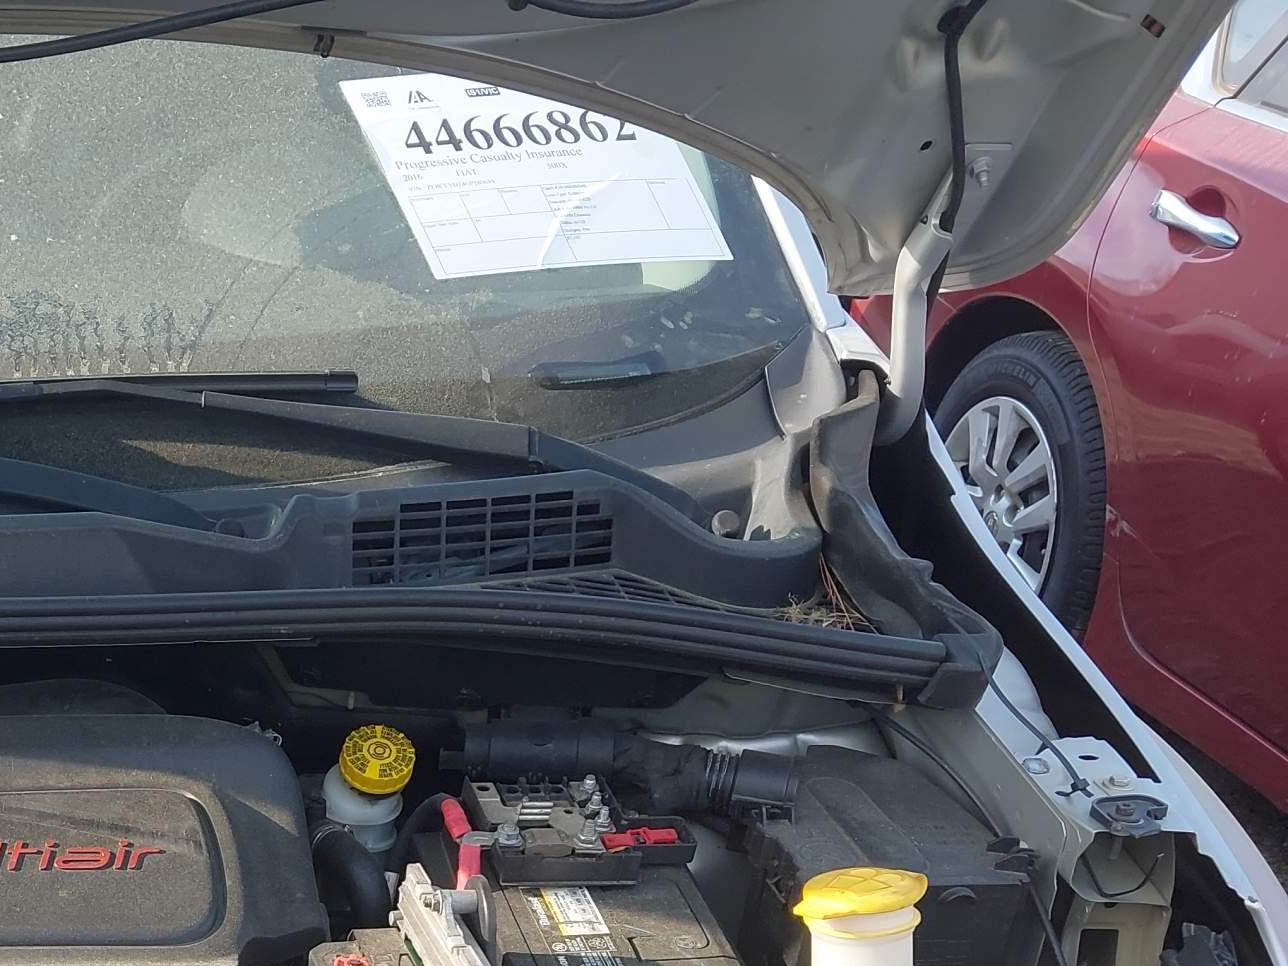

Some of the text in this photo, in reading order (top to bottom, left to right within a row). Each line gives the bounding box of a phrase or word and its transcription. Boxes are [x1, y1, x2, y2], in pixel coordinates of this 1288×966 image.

[405, 109, 637, 154] 44666862
[395, 147, 583, 171] Progressive Casualty Insurance
